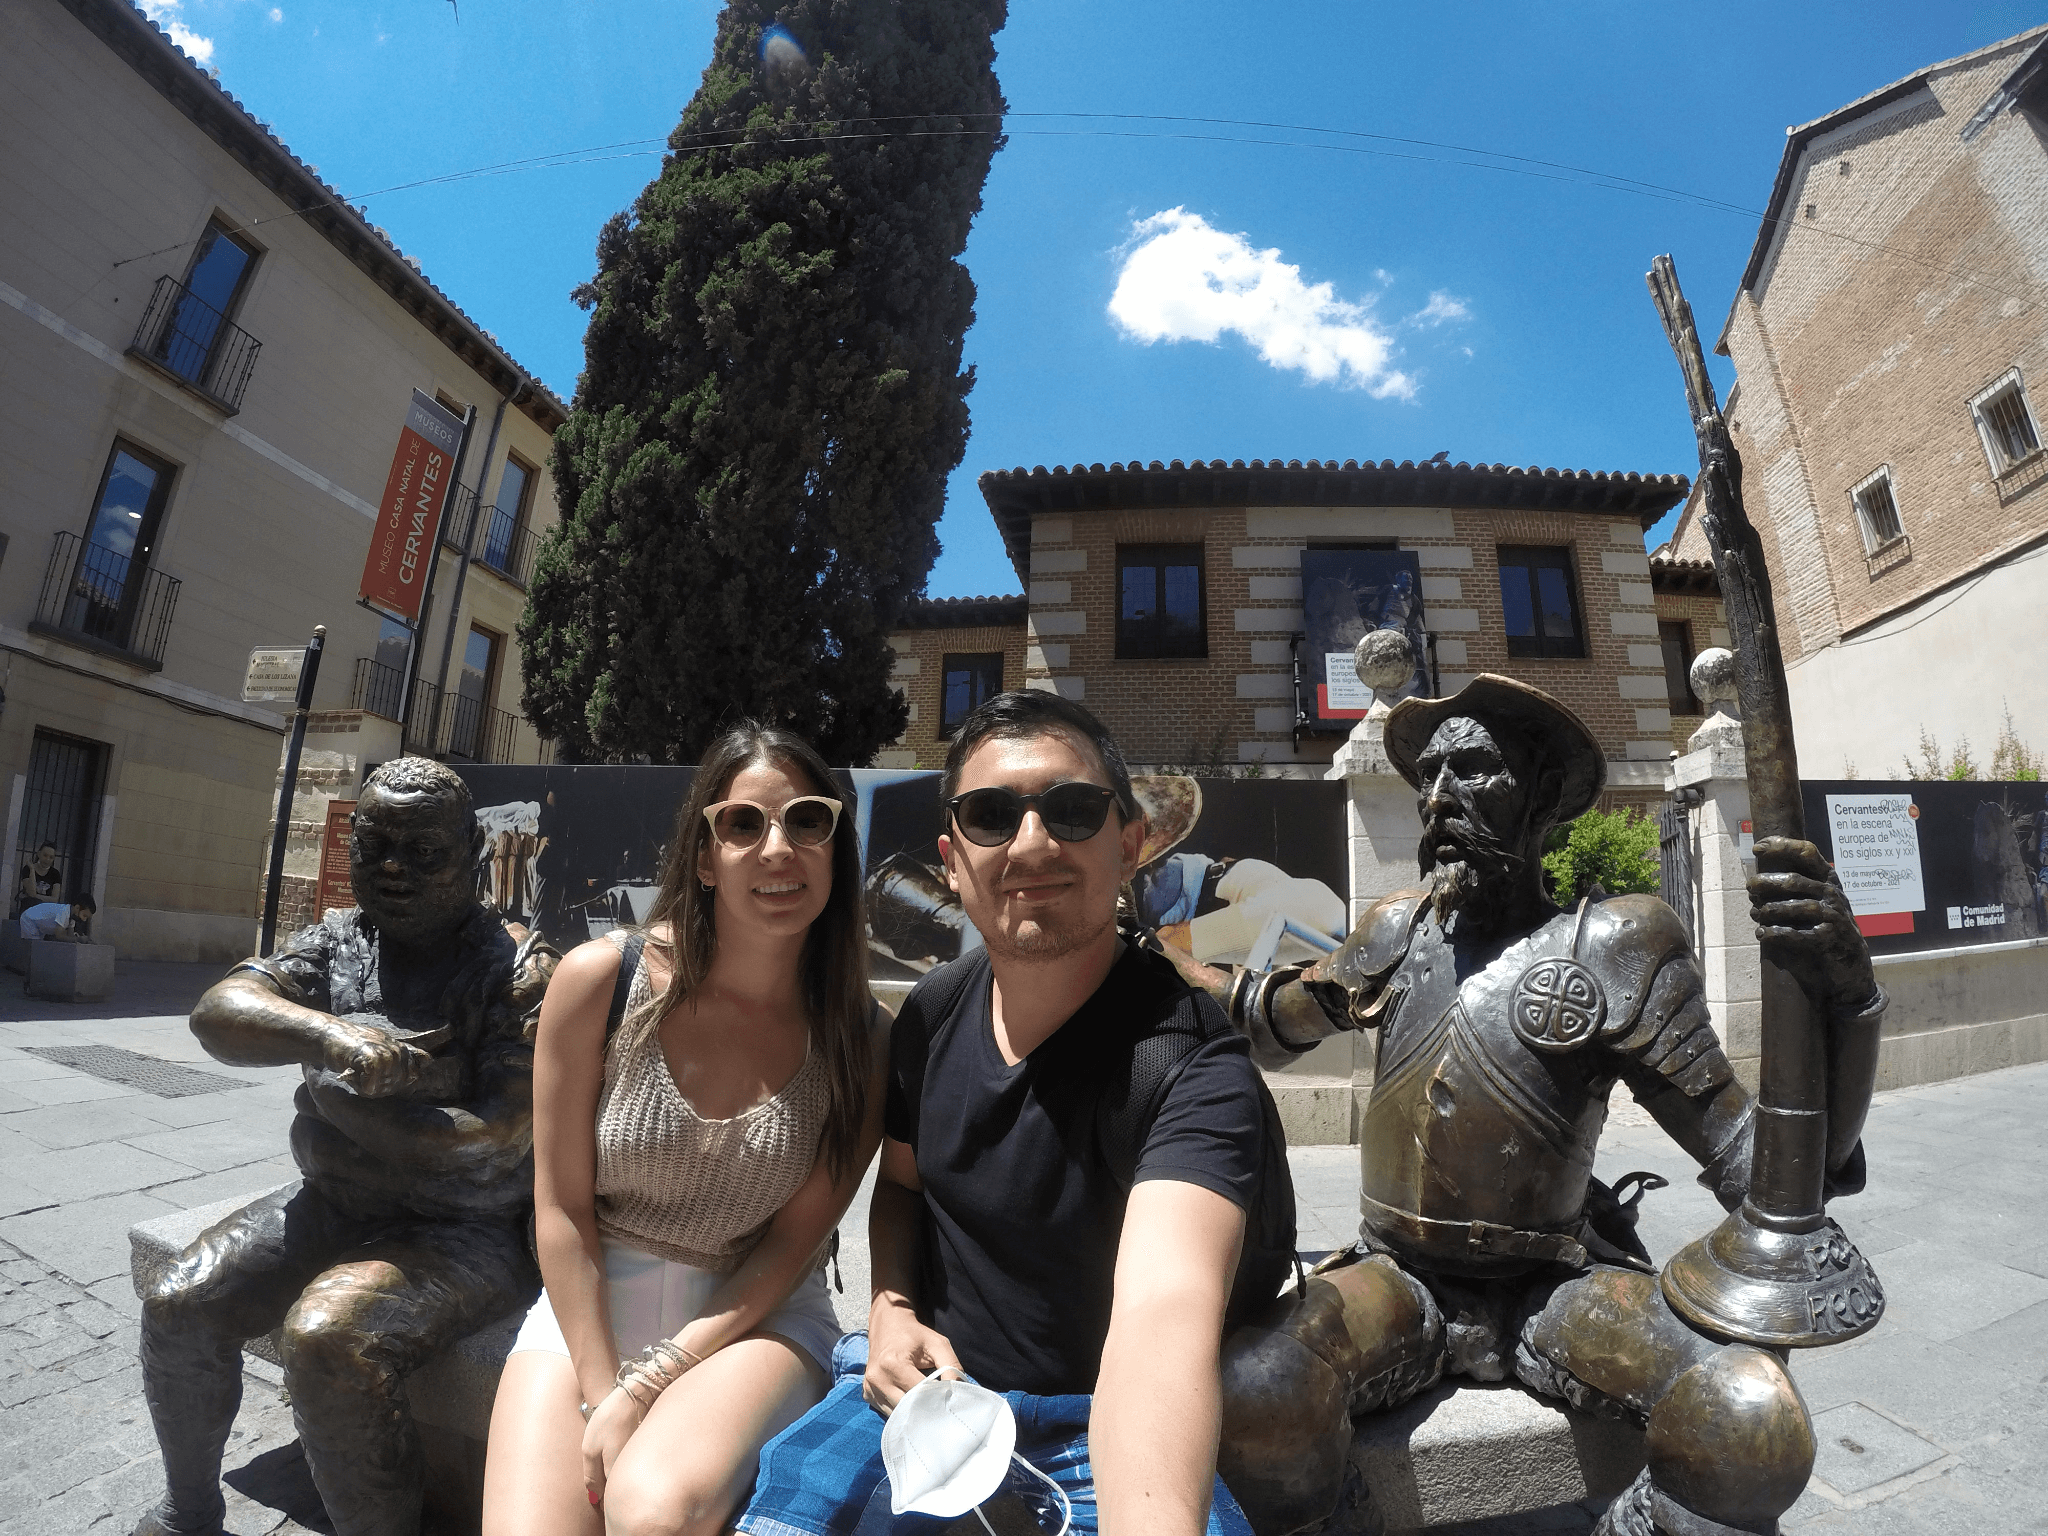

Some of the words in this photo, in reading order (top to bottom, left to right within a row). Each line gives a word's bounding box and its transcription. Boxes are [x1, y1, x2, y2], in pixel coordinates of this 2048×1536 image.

[414, 410, 453, 444] MUSEOS
[378, 531, 396, 575] MUSEO
[389, 497, 405, 529] CASA
[398, 458, 416, 494] NATAL
[409, 438, 421, 456] DE
[398, 450, 442, 584] CERVANTES
[1834, 803, 1884, 815] Cervantes
[1836, 820, 1848, 829] en
[1850, 818, 1859, 829] la
[1861, 819, 1893, 829] escena
[1838, 834, 1876, 845] europea
[1877, 832, 1889, 842] de
[1840, 847, 1854, 858] los
[1856, 846, 1883, 861] siglos
[1895, 847, 1901, 859] y
[1842, 870, 1850, 878] 13
[1859, 871, 1876, 879] mayo
[1843, 881, 1851, 889] 17
[1861, 880, 1883, 888] octubre
[1887, 879, 1900, 887] 2021
[1962, 903, 2004, 916] Comunidad
[1963, 916, 1975, 928] de
[1976, 914, 2005, 927] Madrid
